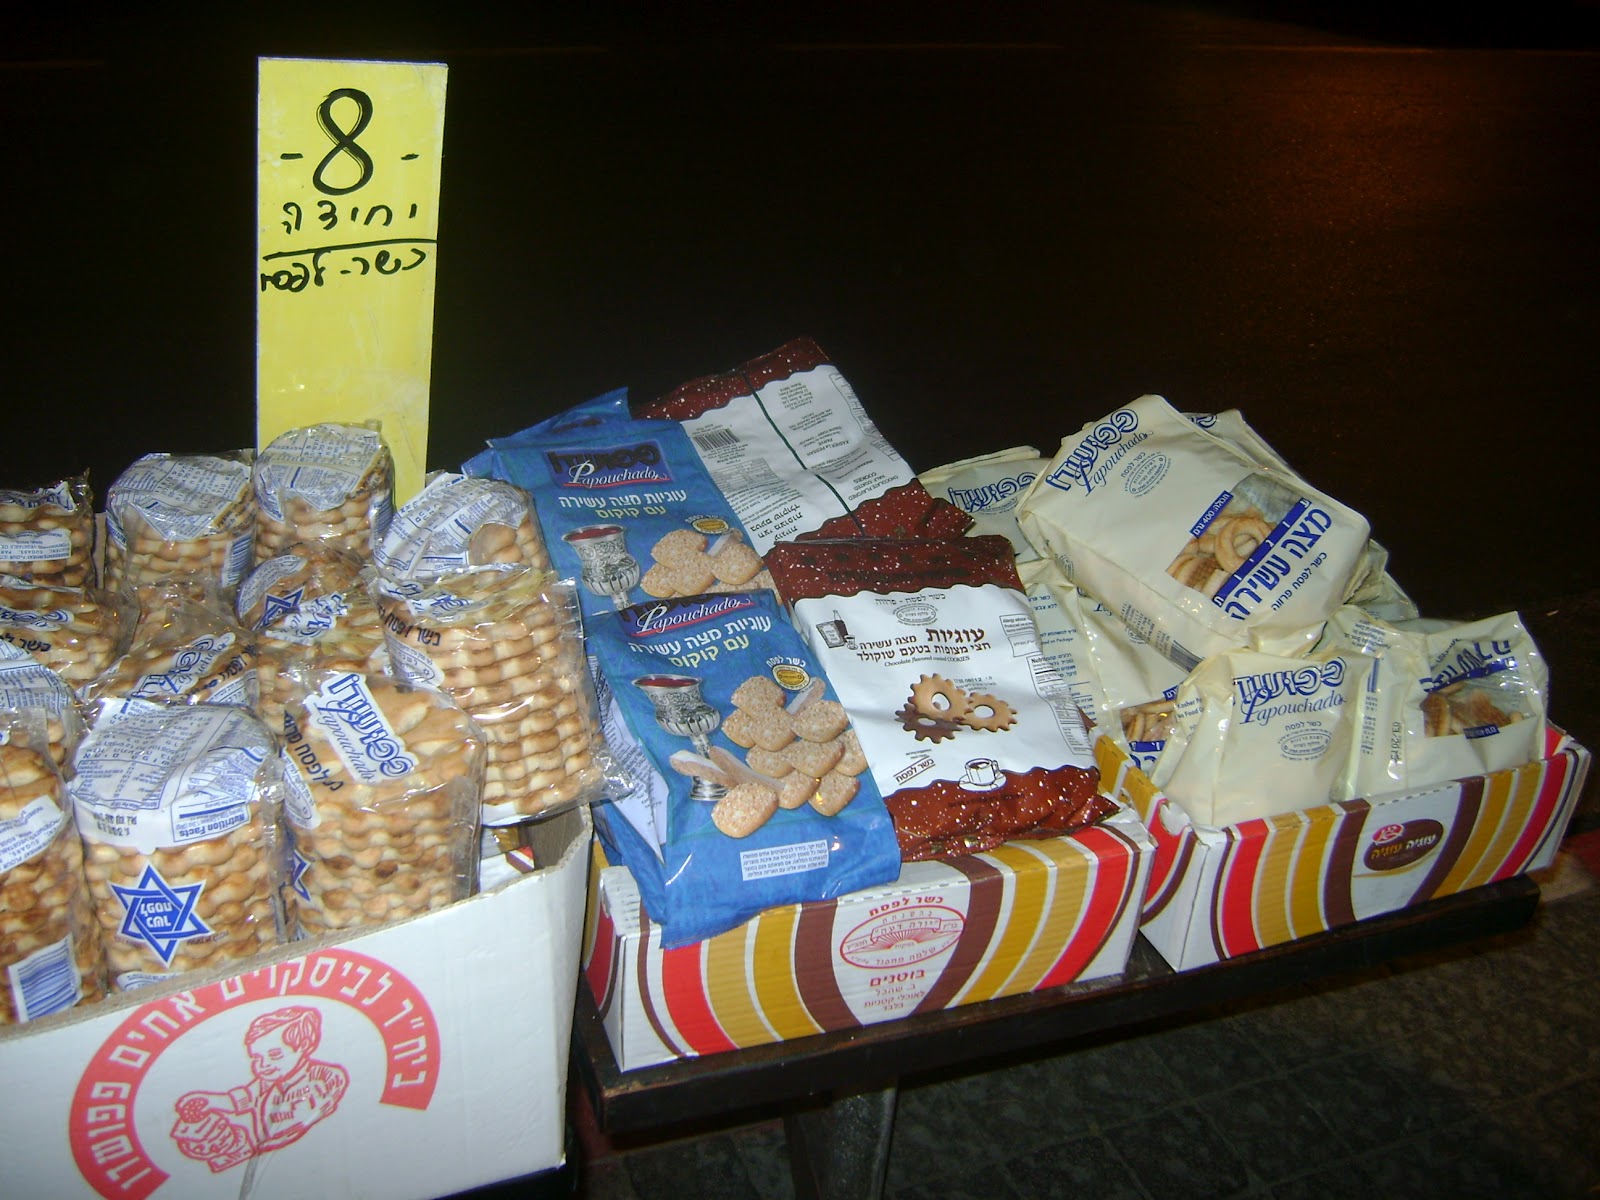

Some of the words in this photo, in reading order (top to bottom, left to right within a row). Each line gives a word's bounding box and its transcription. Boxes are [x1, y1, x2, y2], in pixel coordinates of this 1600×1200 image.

[313, 88, 374, 196] 8
[568, 459, 669, 489] Papouchado
[853, 471, 877, 483] COOKIES
[872, 474, 886, 483] HALF
[872, 475, 898, 491] CHOCOLATE
[610, 492, 641, 507] מצה
[646, 489, 688, 504] עוגיות
[848, 486, 872, 500] FLAVORED
[557, 495, 606, 510] עשירה
[594, 506, 640, 520] קוקוס
[646, 505, 668, 516] עם
[1277, 508, 1334, 562] מצה
[1310, 551, 1328, 568] כשר
[1291, 566, 1311, 590] לפסח
[1224, 555, 1291, 621] עשירה
[635, 597, 751, 635] Papouchado
[725, 615, 772, 633] עוגיות
[416, 627, 442, 647] כשר
[684, 627, 722, 646] מצה
[725, 635, 750, 651] עם
[894, 634, 917, 646] מצה
[925, 627, 986, 644] עוגיות
[628, 636, 681, 655] עשירה
[859, 639, 893, 650] עשירה
[899, 645, 931, 657] בטעם
[934, 644, 969, 655] מצופות
[970, 641, 992, 651] חצי
[667, 644, 718, 667] קוקוס
[765, 654, 785, 668] לפסח
[786, 656, 807, 668] כשר
[856, 649, 896, 663] שוקולד
[884, 658, 911, 668] Chocolate
[1176, 699, 1196, 709] Kosher
[1239, 686, 1348, 727] Papouchado
[1184, 708, 1198, 717] Food
[327, 673, 414, 778] פפושדו
[1285, 721, 1304, 732] לפסח
[1306, 720, 1322, 728] כשר
[294, 743, 330, 785] לפסח
[916, 757, 935, 771] כשר
[895, 766, 917, 783] לפסח
[206, 813, 246, 833] Nutrition
[179, 825, 206, 839] Facts
[869, 896, 910, 916] לפסח
[915, 895, 944, 904] כשר
[140, 901, 173, 917] לפסח
[145, 915, 172, 928] כשר
[869, 968, 926, 988] בוטנים
[108, 990, 208, 1069] אחים
[86, 1081, 153, 1191] פפושדו
